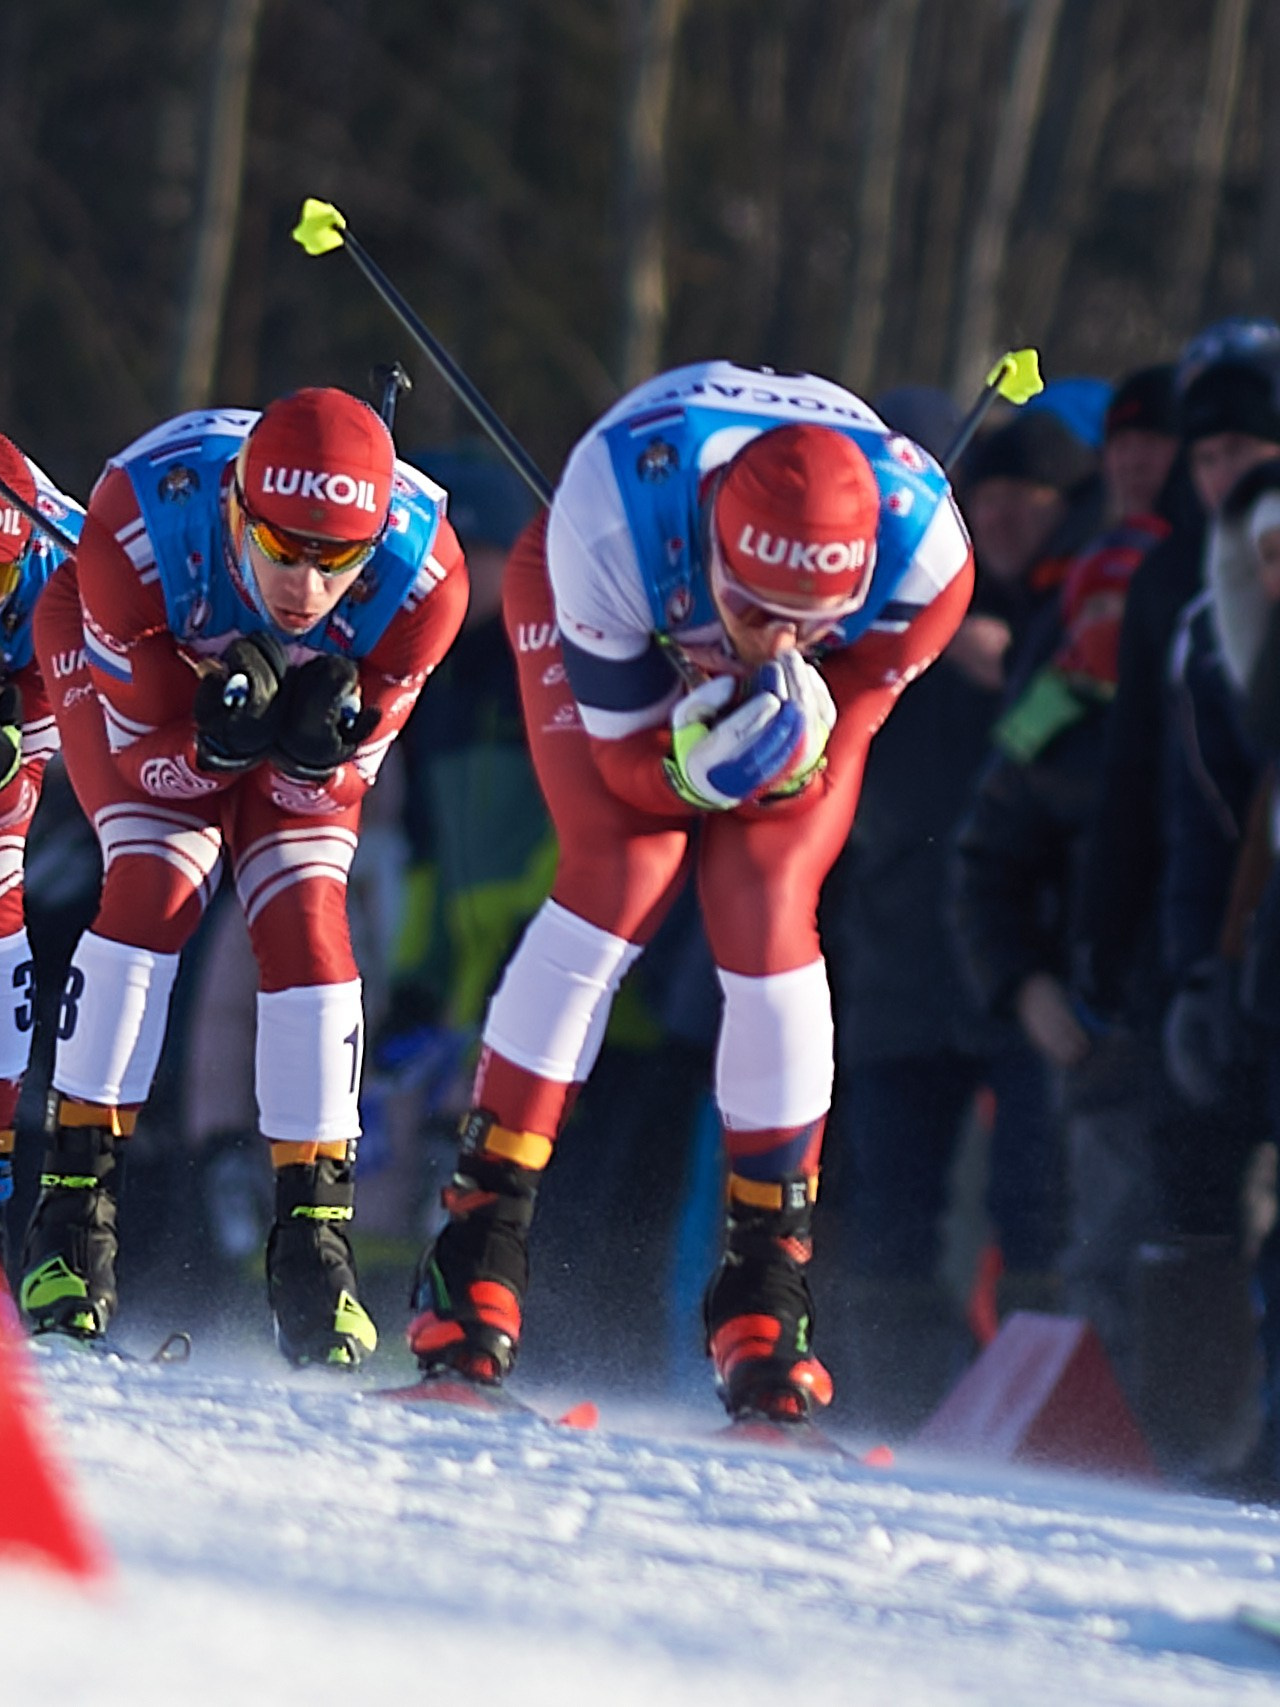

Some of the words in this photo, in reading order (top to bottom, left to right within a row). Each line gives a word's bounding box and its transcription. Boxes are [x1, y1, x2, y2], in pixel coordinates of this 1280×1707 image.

[262, 466, 377, 513] LUKOIL
[13, 960, 36, 1032] 3
[343, 1022, 359, 1094] 1
